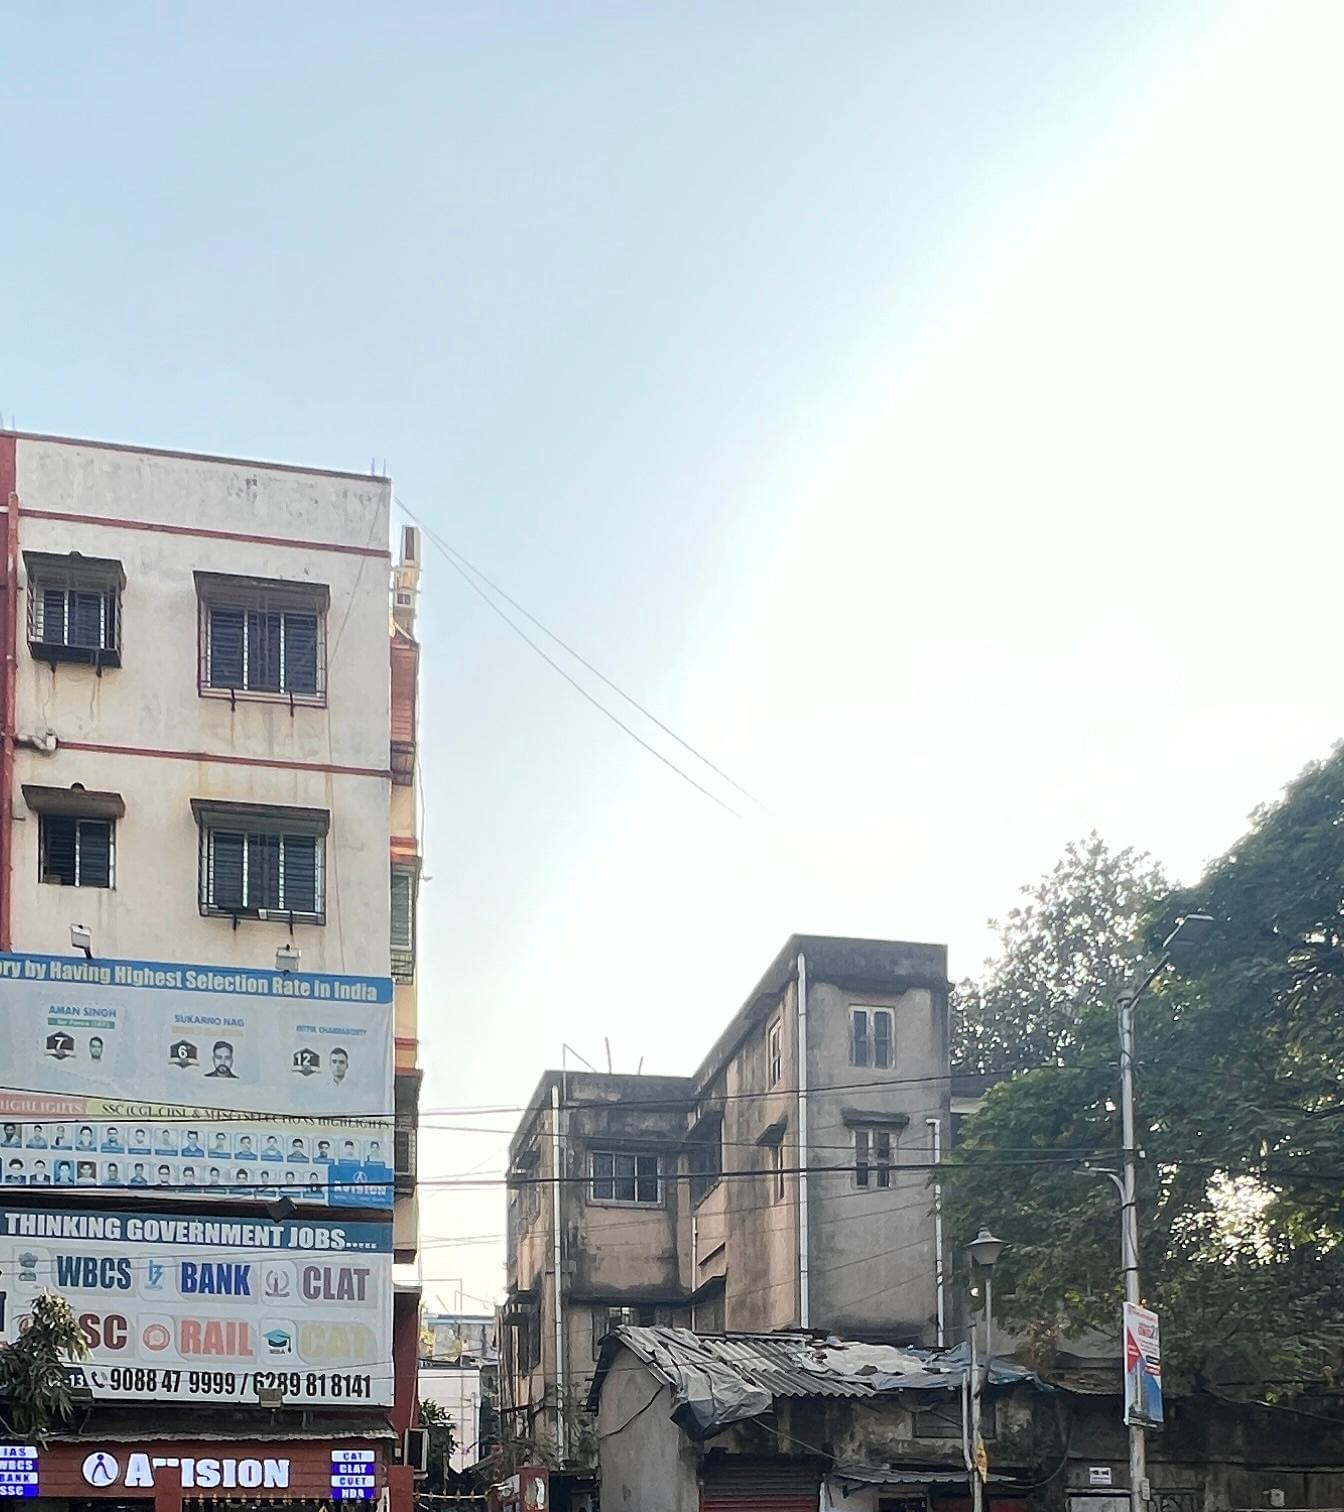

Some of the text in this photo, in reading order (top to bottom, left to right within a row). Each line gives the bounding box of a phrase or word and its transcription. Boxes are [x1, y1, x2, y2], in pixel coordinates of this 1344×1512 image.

[25, 960, 46, 980] by
[50, 959, 111, 985] Having
[115, 965, 182, 988] Highest
[186, 970, 268, 994] Selection
[272, 976, 311, 997] Rate
[335, 981, 378, 1001] India
[48, 1005, 116, 1018] AMAN SINGH
[55, 1036, 65, 1050] 7
[178, 1045, 188, 1059] 6
[295, 1052, 311, 1066] 12
[102, 1103, 124, 1115] SSC
[4, 1213, 122, 1240] THINKING
[127, 1220, 284, 1247] GOVERNMENT
[56, 1255, 132, 1290] WBCS
[181, 1261, 252, 1297] BANK
[302, 1265, 371, 1302] CLAT
[180, 1319, 254, 1357] RAIL
[301, 1323, 369, 1360] CAT
[110, 1368, 157, 1392] 9088
[162, 1370, 181, 1393] 47
[189, 1371, 235, 1397] 9999
[306, 1373, 326, 1397] 81
[330, 1374, 372, 1398] 8141
[3, 1447, 26, 1457] IAS
[343, 1451, 363, 1461] CAT
[339, 1476, 366, 1486] CUET
[0, 1485, 24, 1496] SSC
